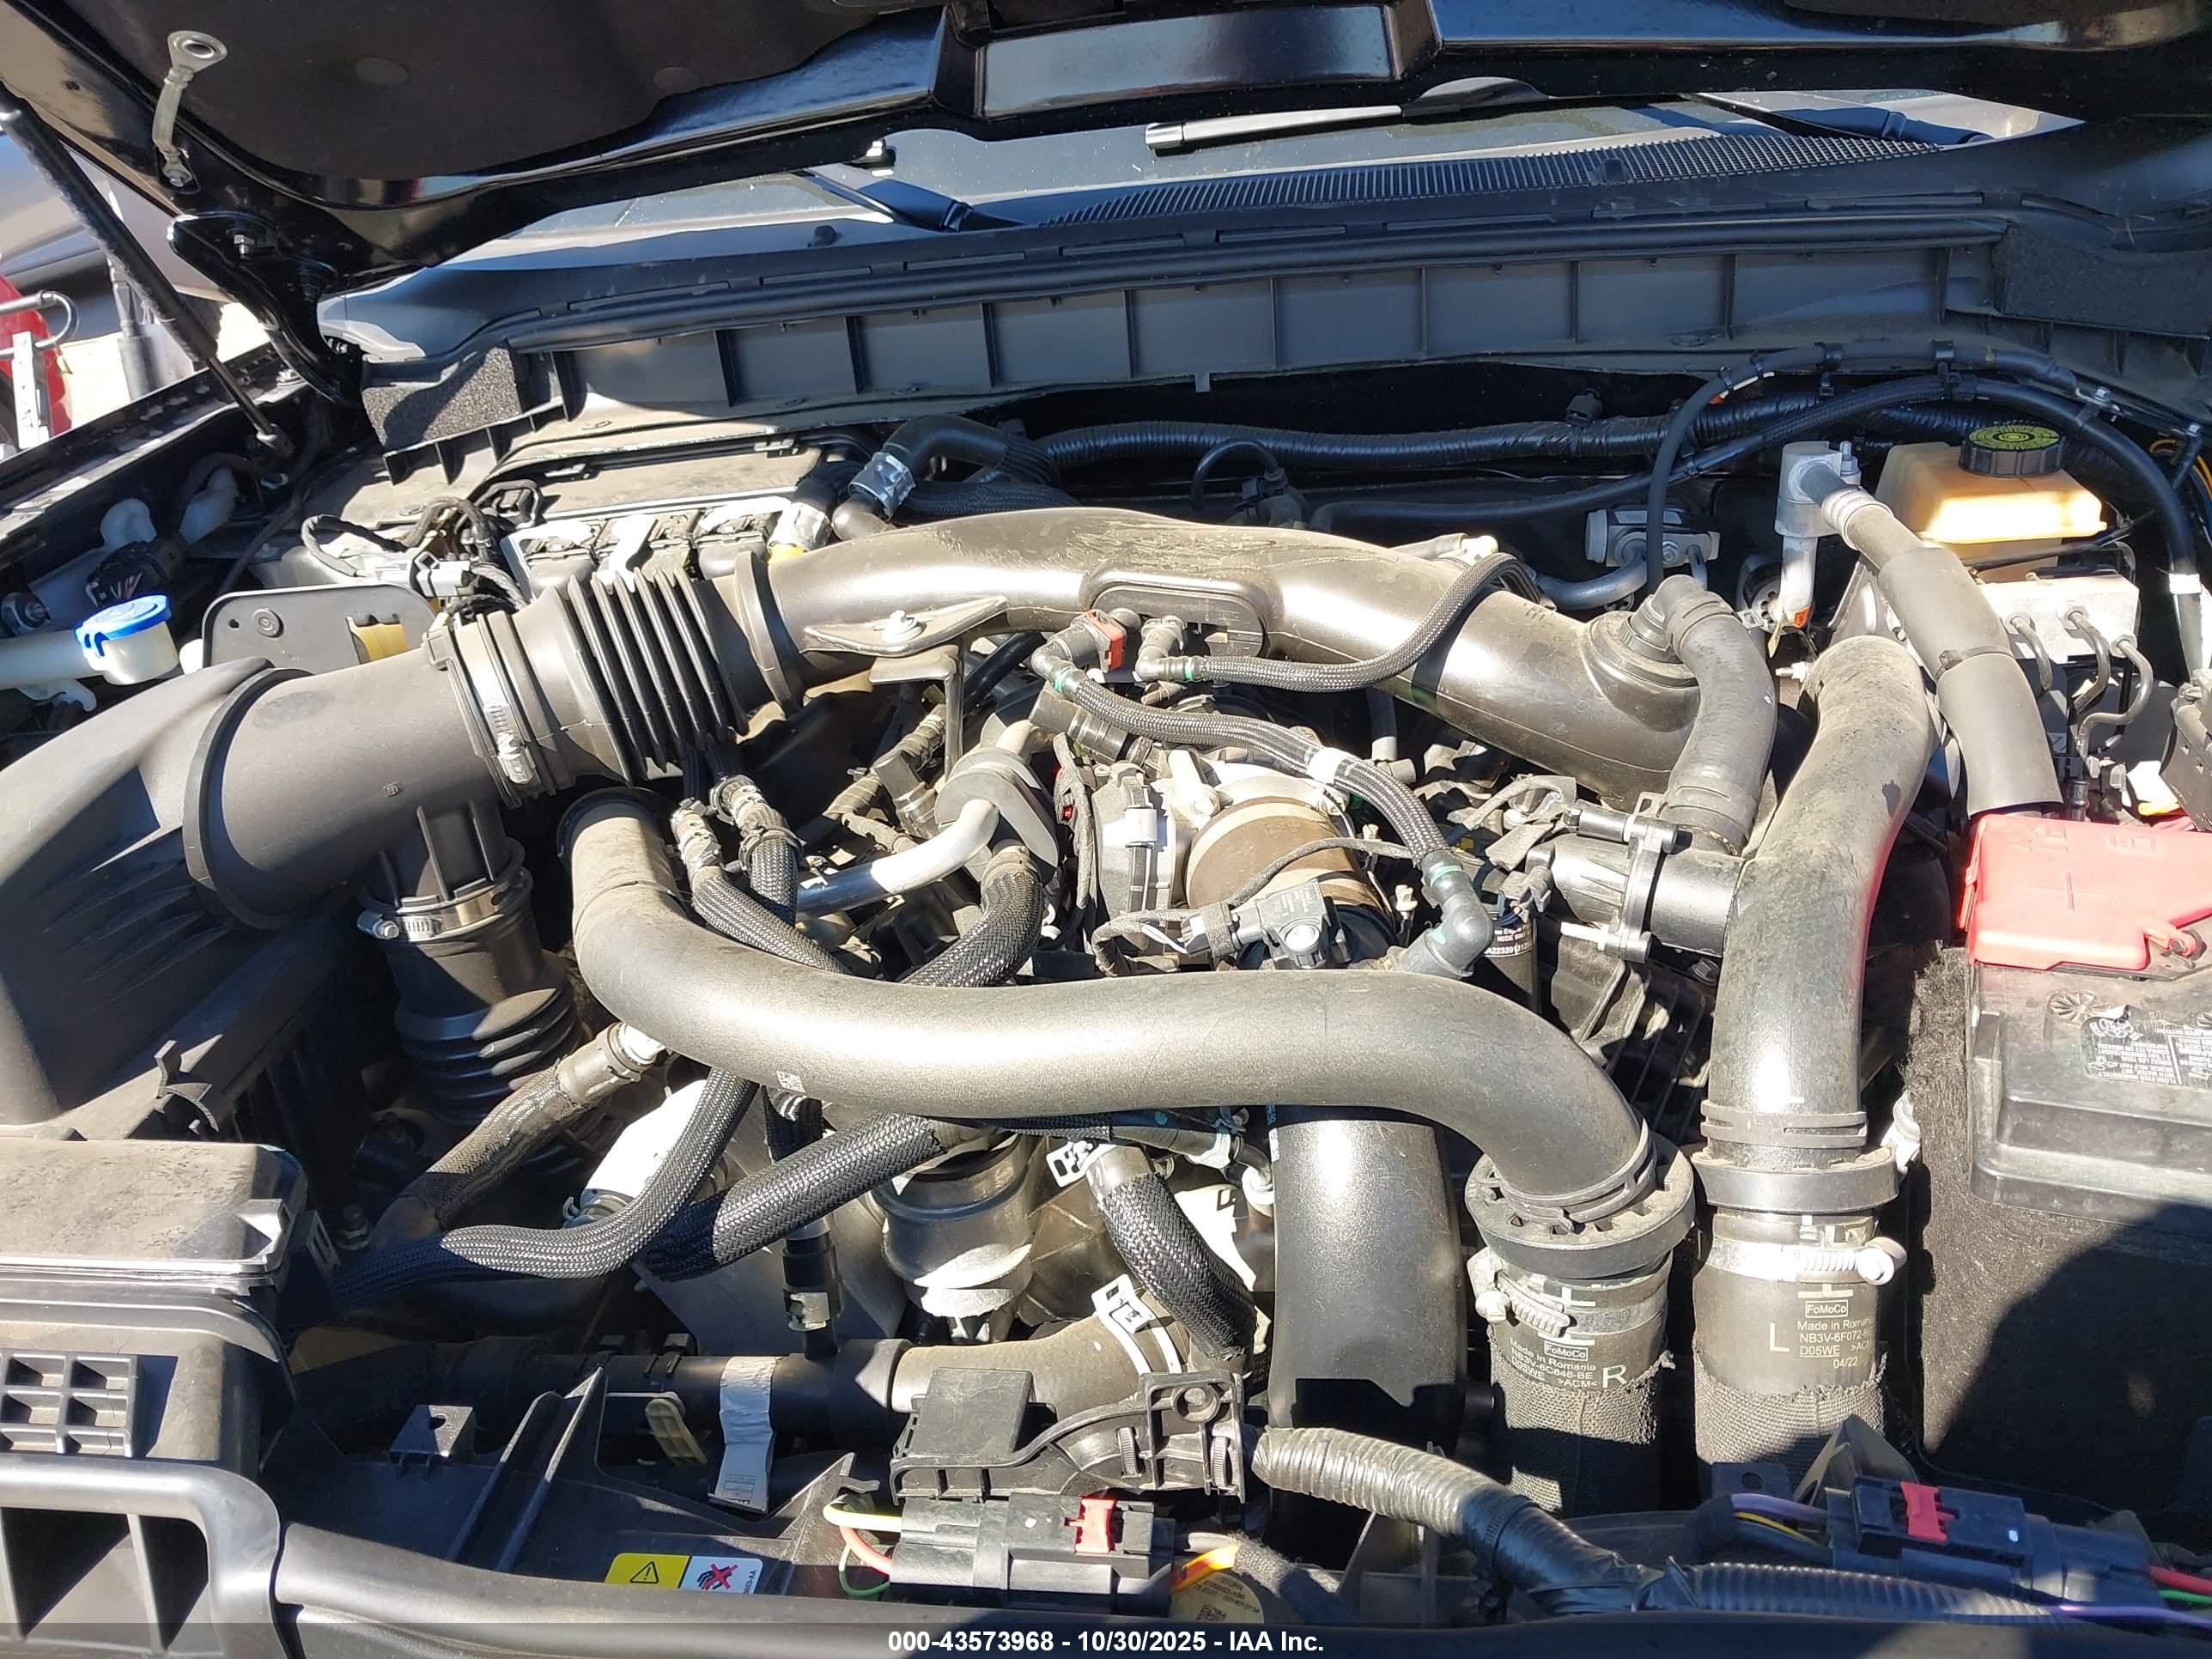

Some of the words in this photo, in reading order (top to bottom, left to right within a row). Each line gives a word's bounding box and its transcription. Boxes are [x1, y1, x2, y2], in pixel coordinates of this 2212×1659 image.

[1807, 1304, 1846, 1315] FoMoCo
[1797, 1321, 1828, 1331] Made
[1831, 1321, 1840, 1330] in
[1769, 1322, 1790, 1352] L
[1510, 1337, 1534, 1358] Made
[1536, 1353, 1547, 1364] in
[1548, 1358, 1596, 1371] Romania
[1546, 1346, 1586, 1358] FoMoCo
[1800, 1346, 1840, 1357] D05WE
[1832, 1357, 1858, 1370] 04/22
[1602, 1364, 1627, 1389] R
